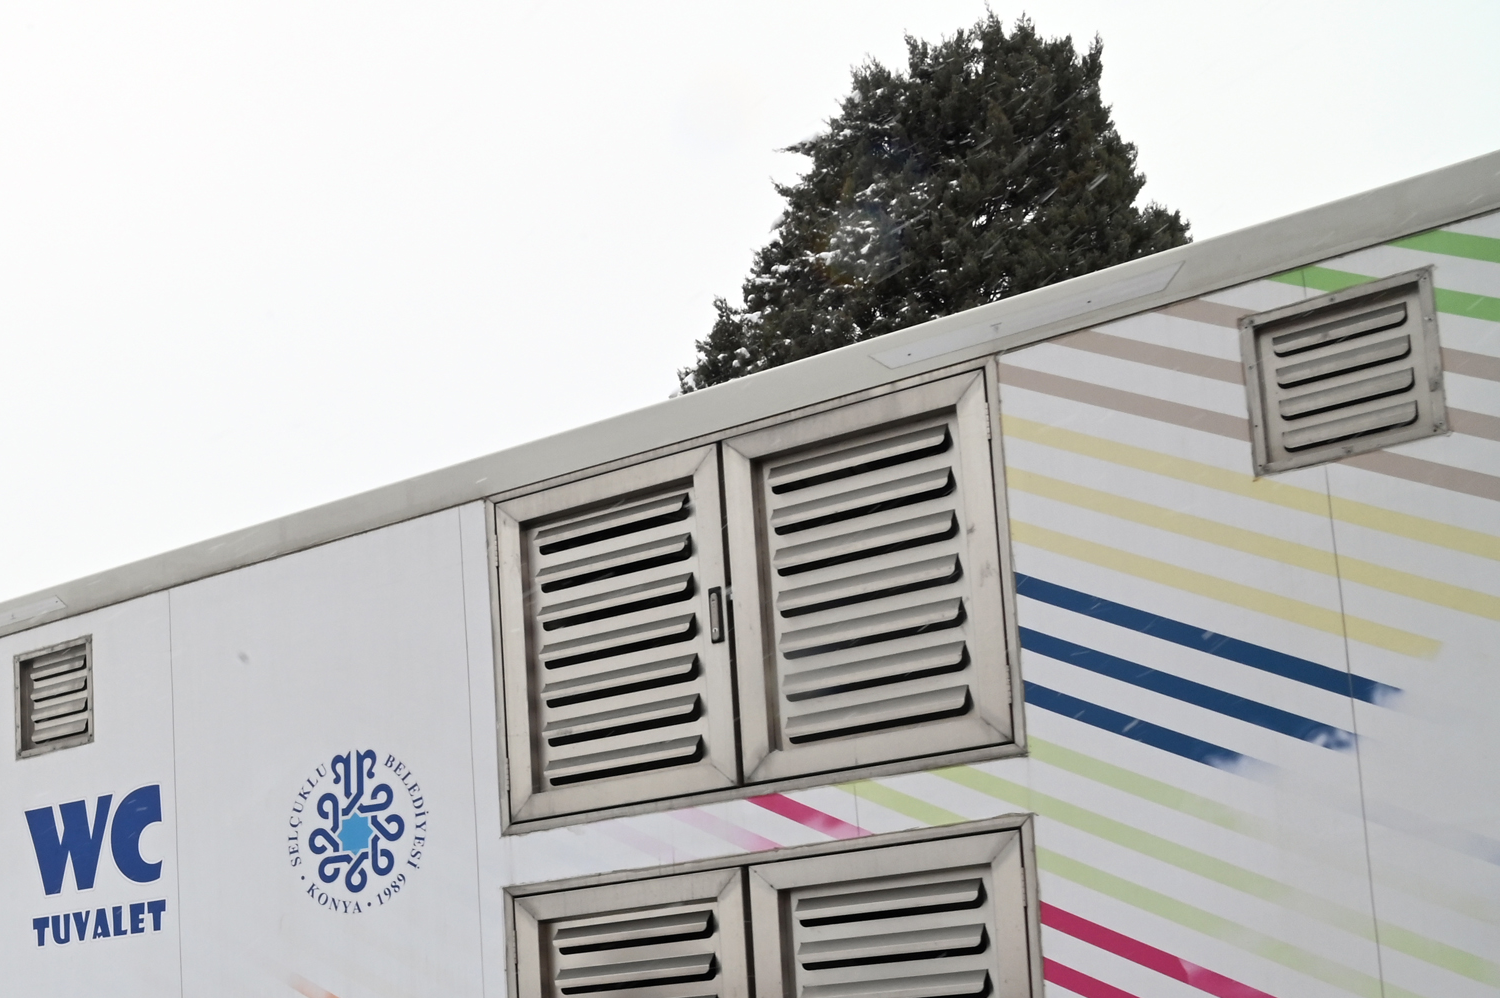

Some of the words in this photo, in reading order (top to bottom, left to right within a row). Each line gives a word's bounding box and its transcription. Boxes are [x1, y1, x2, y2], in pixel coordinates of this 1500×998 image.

[288, 763, 328, 867] SELÇUKLU
[384, 754, 429, 869] BELEDİYESİ
[24, 784, 163, 896] WC
[306, 882, 362, 914] KONYA
[376, 873, 406, 906] 1989
[32, 899, 166, 947] TUVALET
